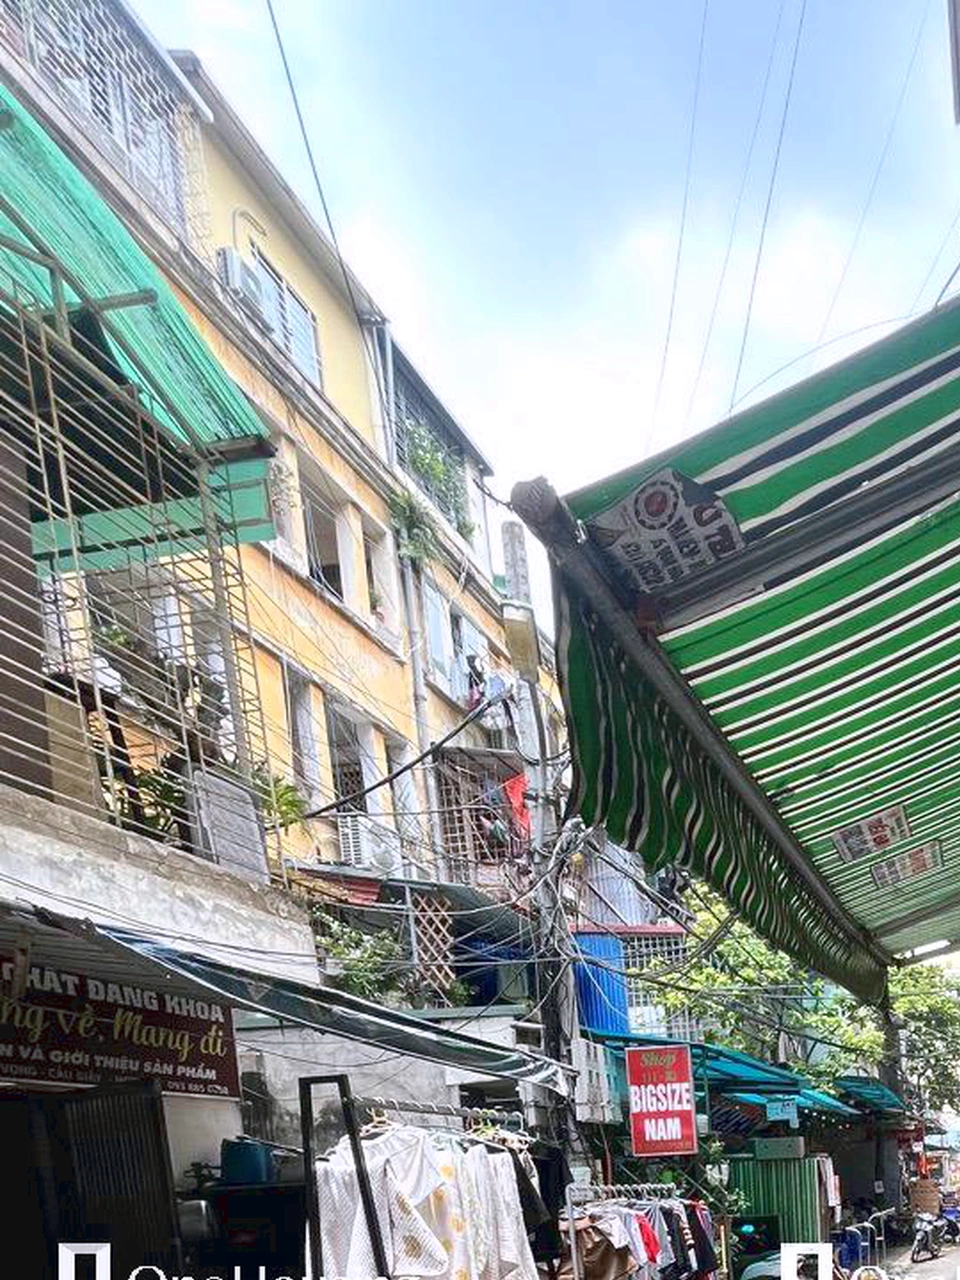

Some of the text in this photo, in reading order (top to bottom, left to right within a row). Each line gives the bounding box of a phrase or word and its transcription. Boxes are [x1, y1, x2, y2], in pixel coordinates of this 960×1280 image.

[165, 994, 225, 1022] KHOA
[113, 1007, 195, 1062] Mang
[630, 1082, 692, 1113] BIGSIZE
[644, 1117, 682, 1141] NAM
